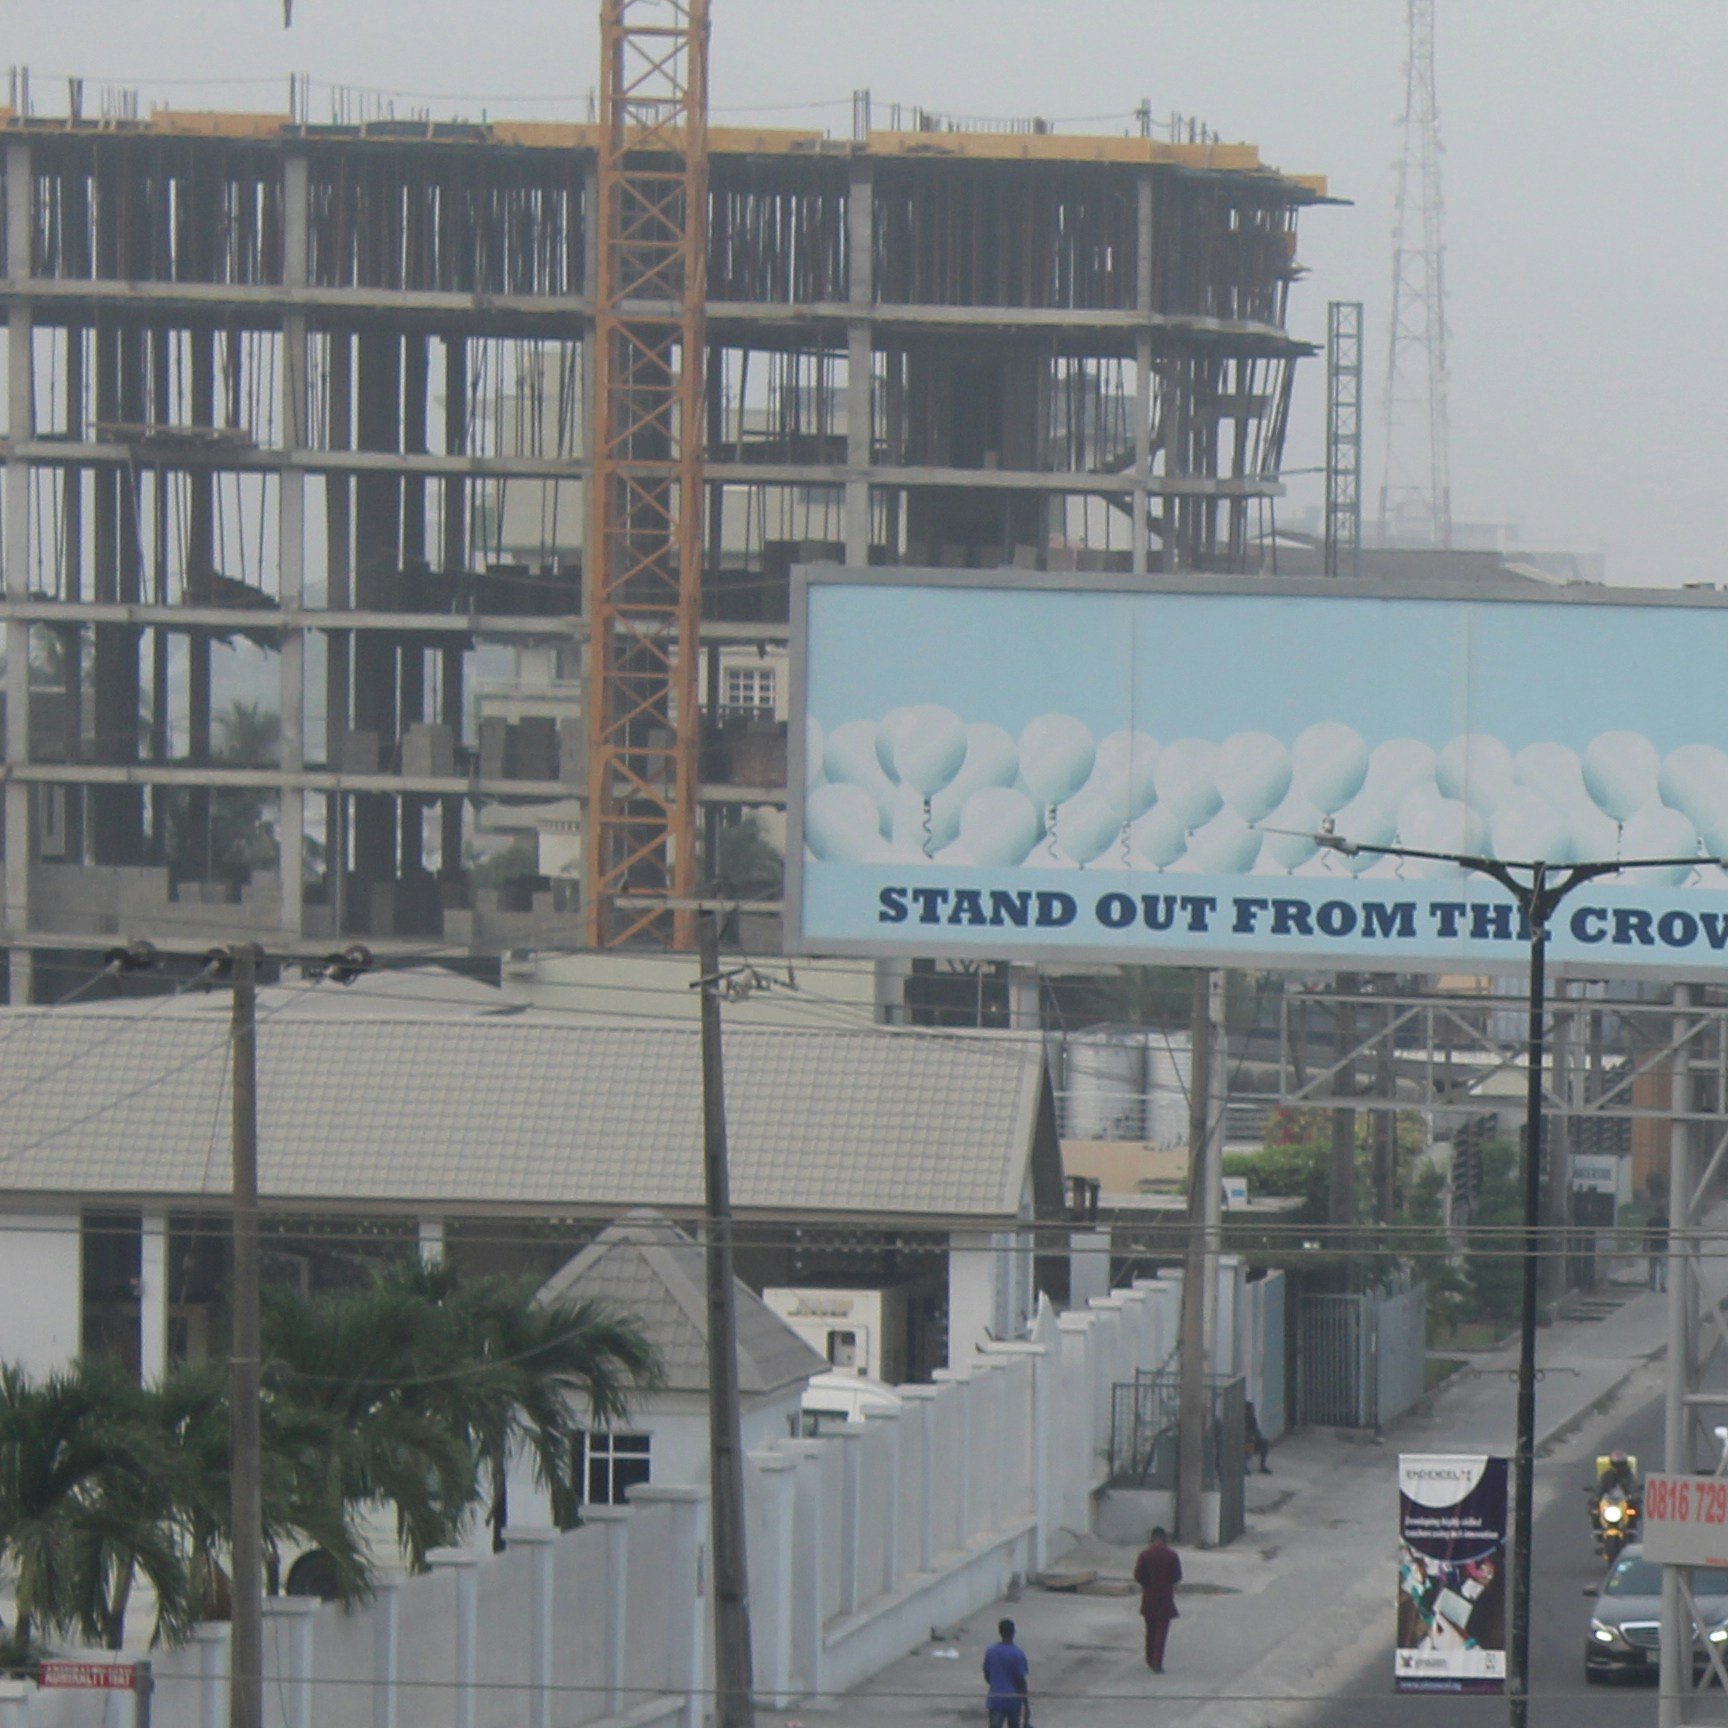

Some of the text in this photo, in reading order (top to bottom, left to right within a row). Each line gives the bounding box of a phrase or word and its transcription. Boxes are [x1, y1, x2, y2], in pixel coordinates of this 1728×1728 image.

[878, 886, 1077, 927] STAND
[1095, 891, 1217, 933] OUT
[1231, 896, 1417, 940] FROM
[1647, 1479, 1689, 1522] 0816
[1695, 1481, 1728, 1525] 729
